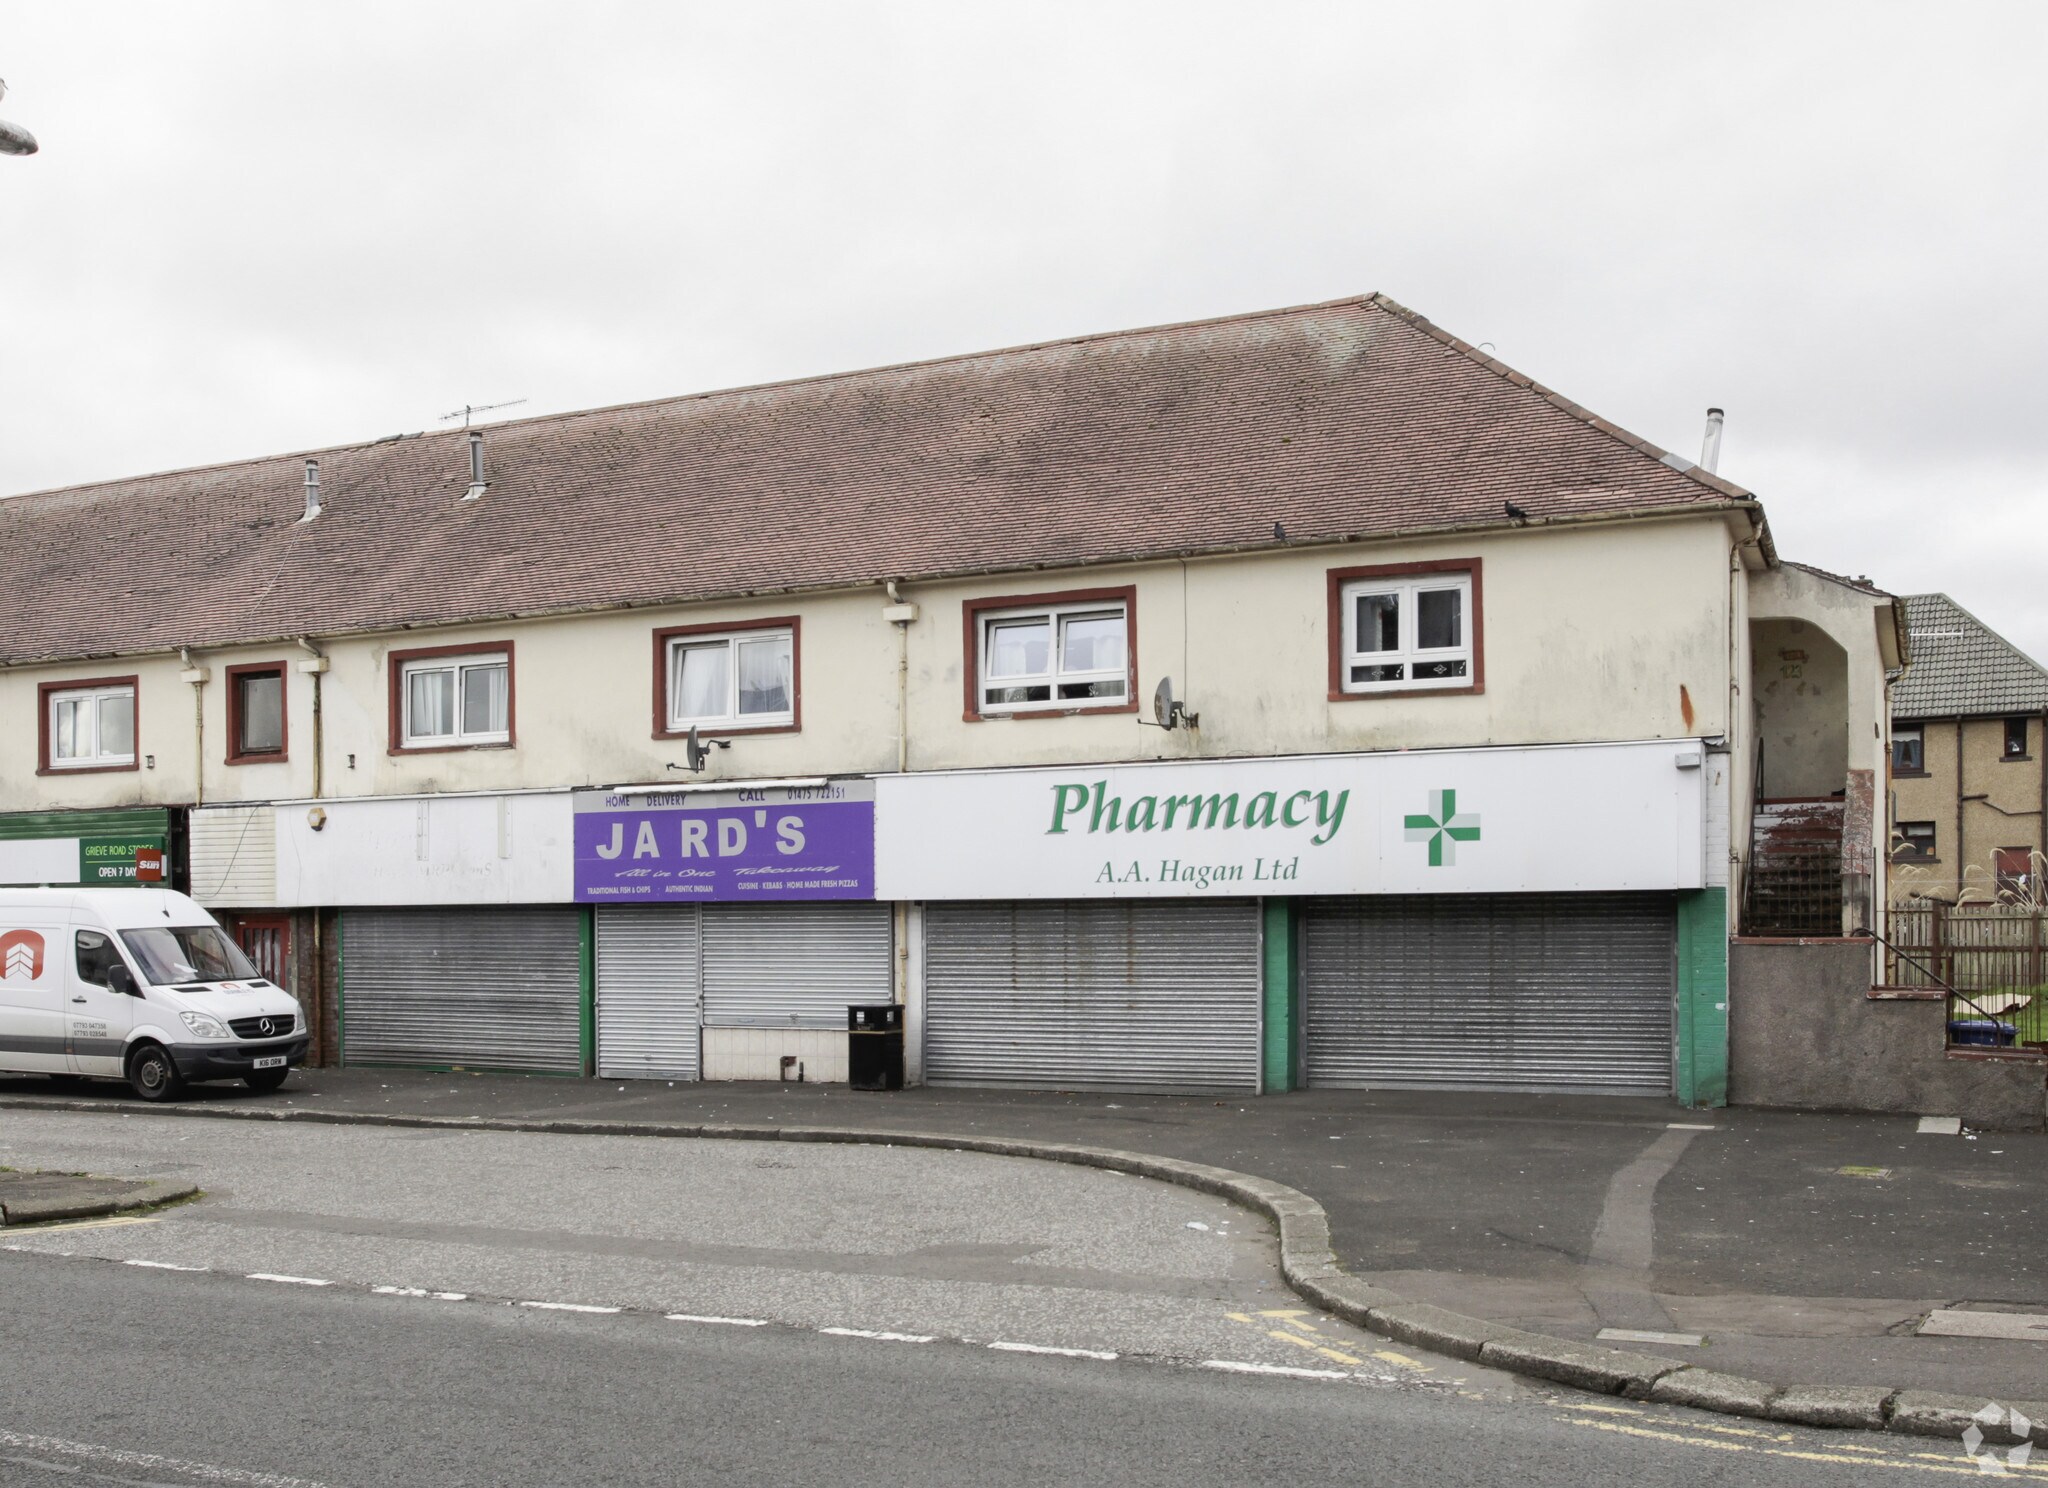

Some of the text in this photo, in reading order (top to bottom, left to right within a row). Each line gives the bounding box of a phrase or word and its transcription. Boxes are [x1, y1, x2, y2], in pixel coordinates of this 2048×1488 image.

[605, 787, 845, 808] HOME DELIVERY CALL 01475 722151
[1044, 780, 1351, 847] Pharmacy
[85, 845, 107, 856] GRIEVE
[109, 845, 127, 856] ROAD
[98, 867, 137, 877] OPEN 7 DAY
[139, 860, 160, 870] Sun
[614, 865, 841, 878] All in One Takeaway
[1095, 856, 1300, 890] A.A. Hagan Ltd
[587, 887, 619, 895] TRADITIONAL
[619, 886, 631, 894] FISH
[636, 886, 651, 894] CHIPS
[665, 885, 693, 893] AUTHENTIC
[693, 885, 713, 893] INDIAN
[737, 882, 759, 890] CUISINE
[762, 881, 783, 889] KEBABS
[786, 881, 804, 889] HOME
[804, 880, 820, 889] MADE
[820, 880, 838, 888] FRESH
[838, 879, 859, 888] PIZZAS
